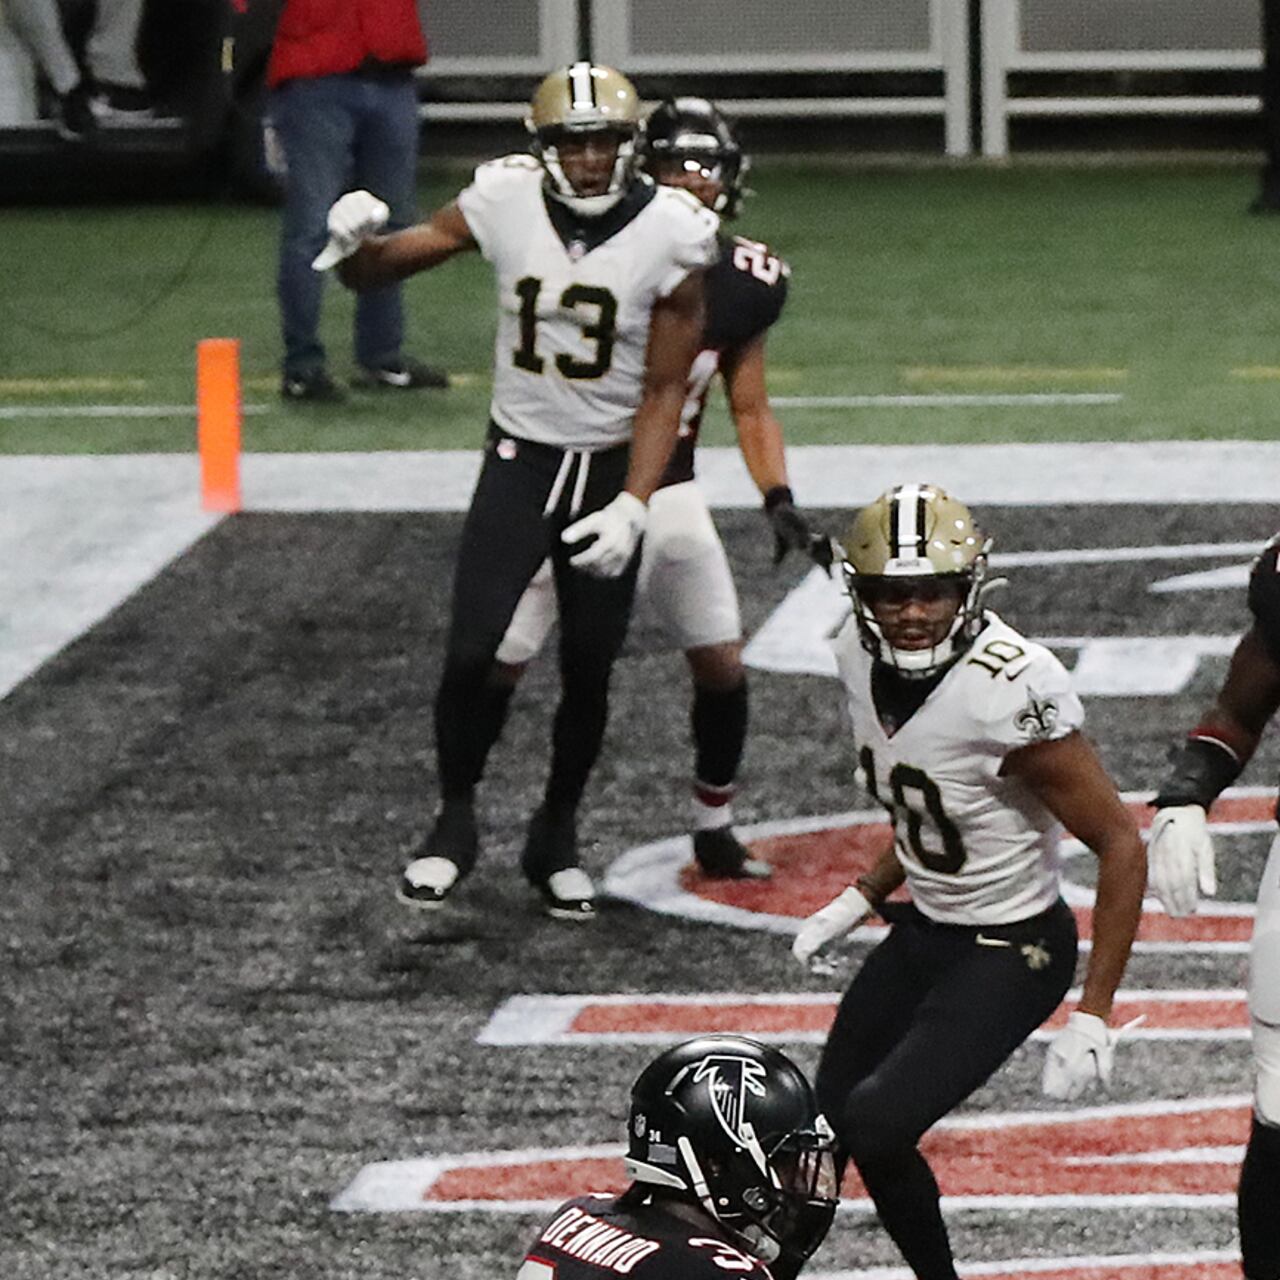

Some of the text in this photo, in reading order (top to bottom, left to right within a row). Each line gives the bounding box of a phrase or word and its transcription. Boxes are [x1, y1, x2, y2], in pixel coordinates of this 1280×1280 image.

[733, 237, 779, 286] 2
[512, 276, 618, 379] 13
[966, 639, 1025, 680] 10
[858, 745, 967, 875] 10
[540, 1206, 662, 1274] DENNARD
